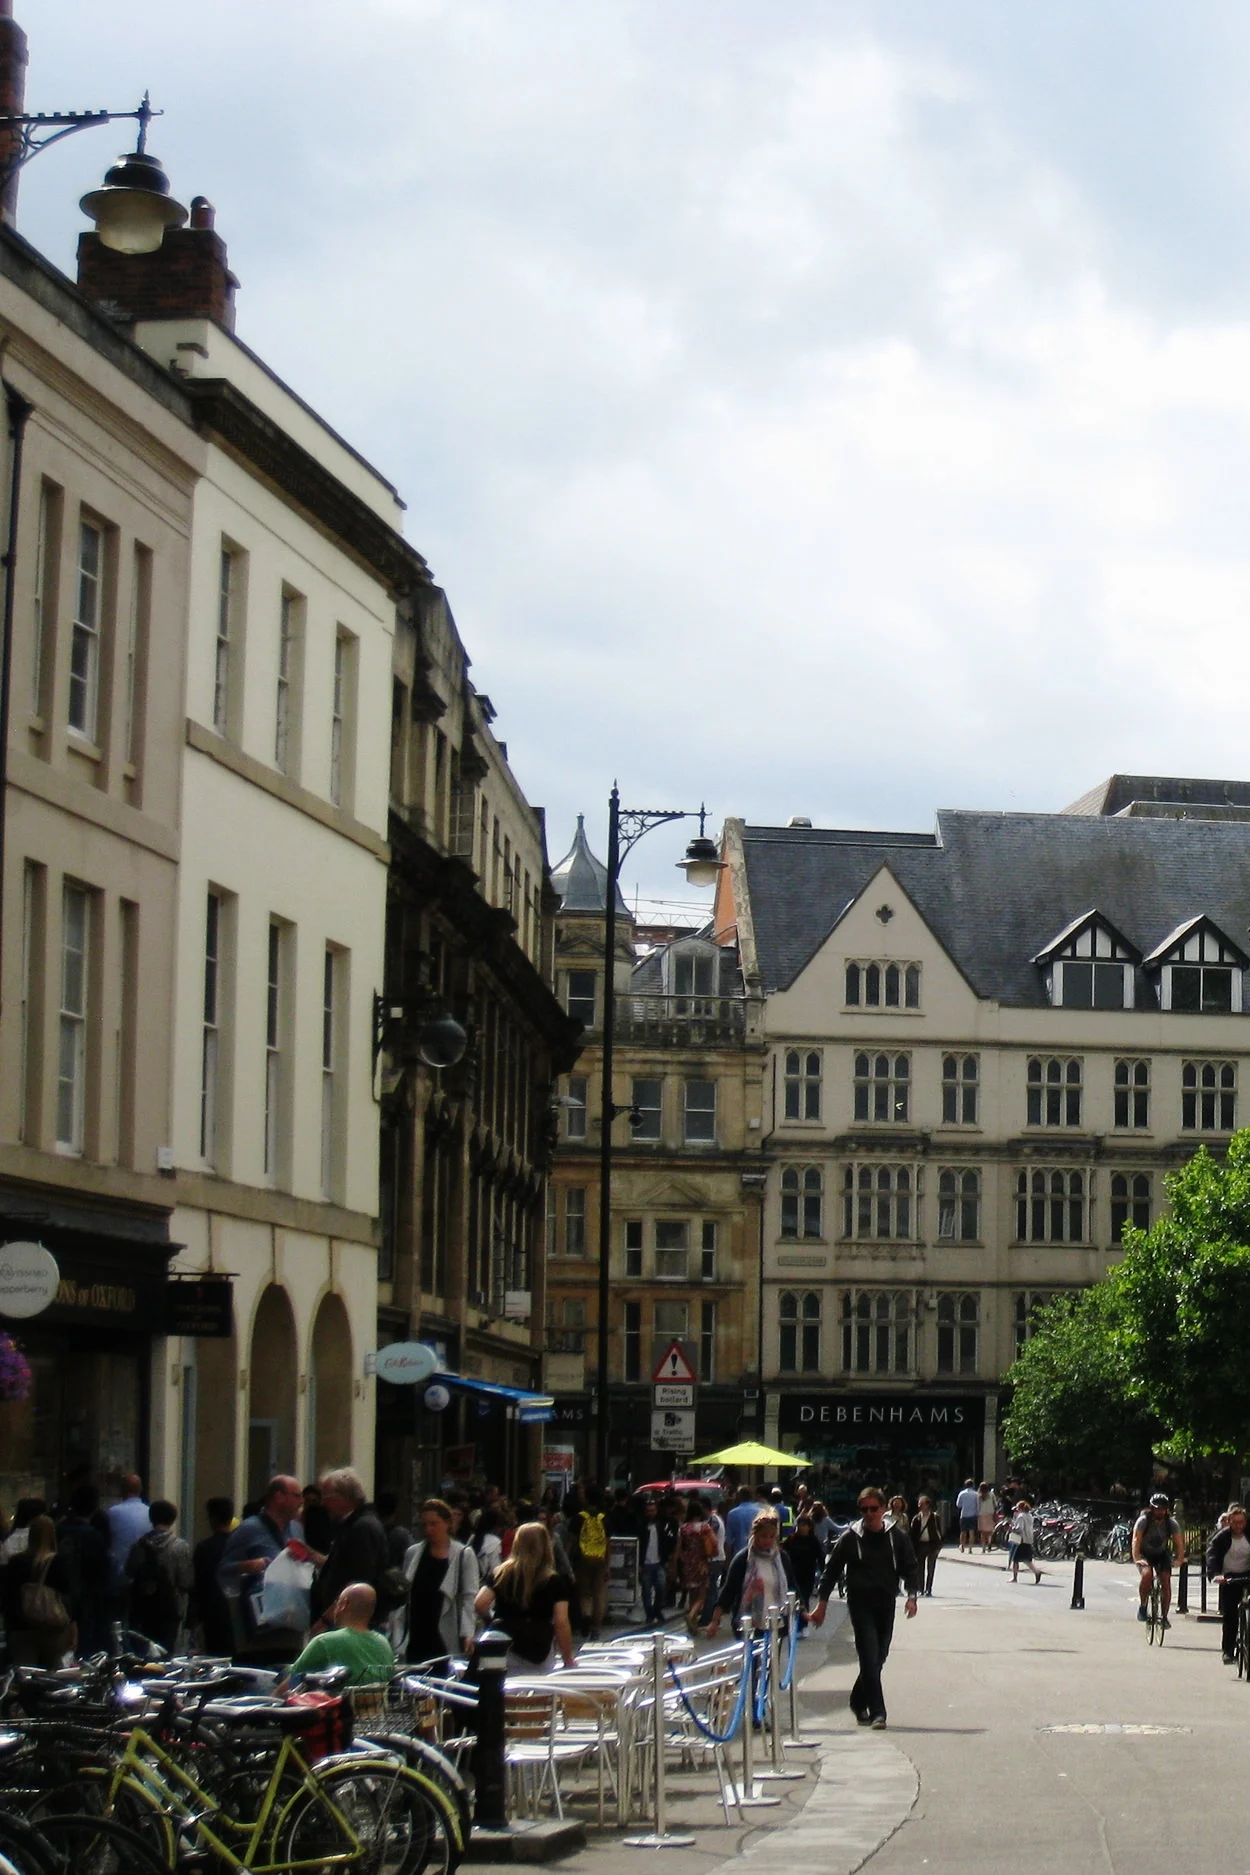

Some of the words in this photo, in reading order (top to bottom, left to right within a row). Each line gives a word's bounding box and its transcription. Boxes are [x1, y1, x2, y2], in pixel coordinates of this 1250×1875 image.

[91, 1284, 136, 1312] OXFORD
[662, 1387, 686, 1395] Rising
[800, 1406, 964, 1423] DEBENHAMS
